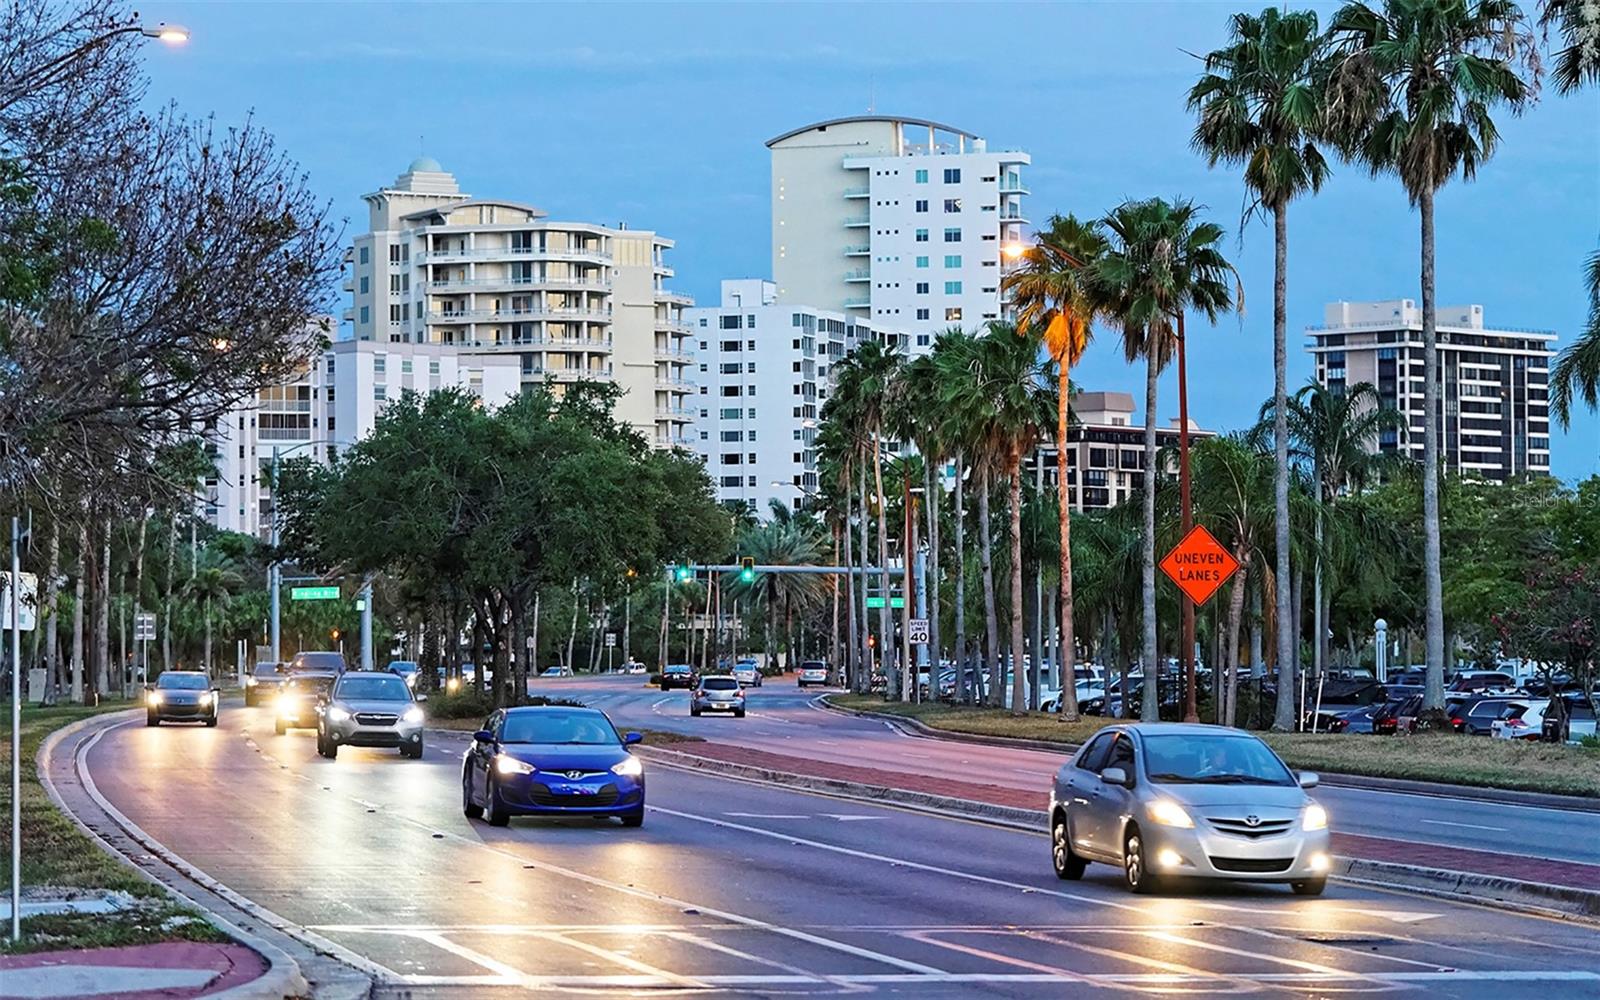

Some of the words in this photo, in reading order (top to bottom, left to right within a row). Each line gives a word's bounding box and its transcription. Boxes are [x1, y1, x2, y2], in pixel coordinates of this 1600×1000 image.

[1174, 552, 1224, 564] UNEVEN
[1179, 569, 1220, 581] LANES
[910, 632, 928, 642] 40
